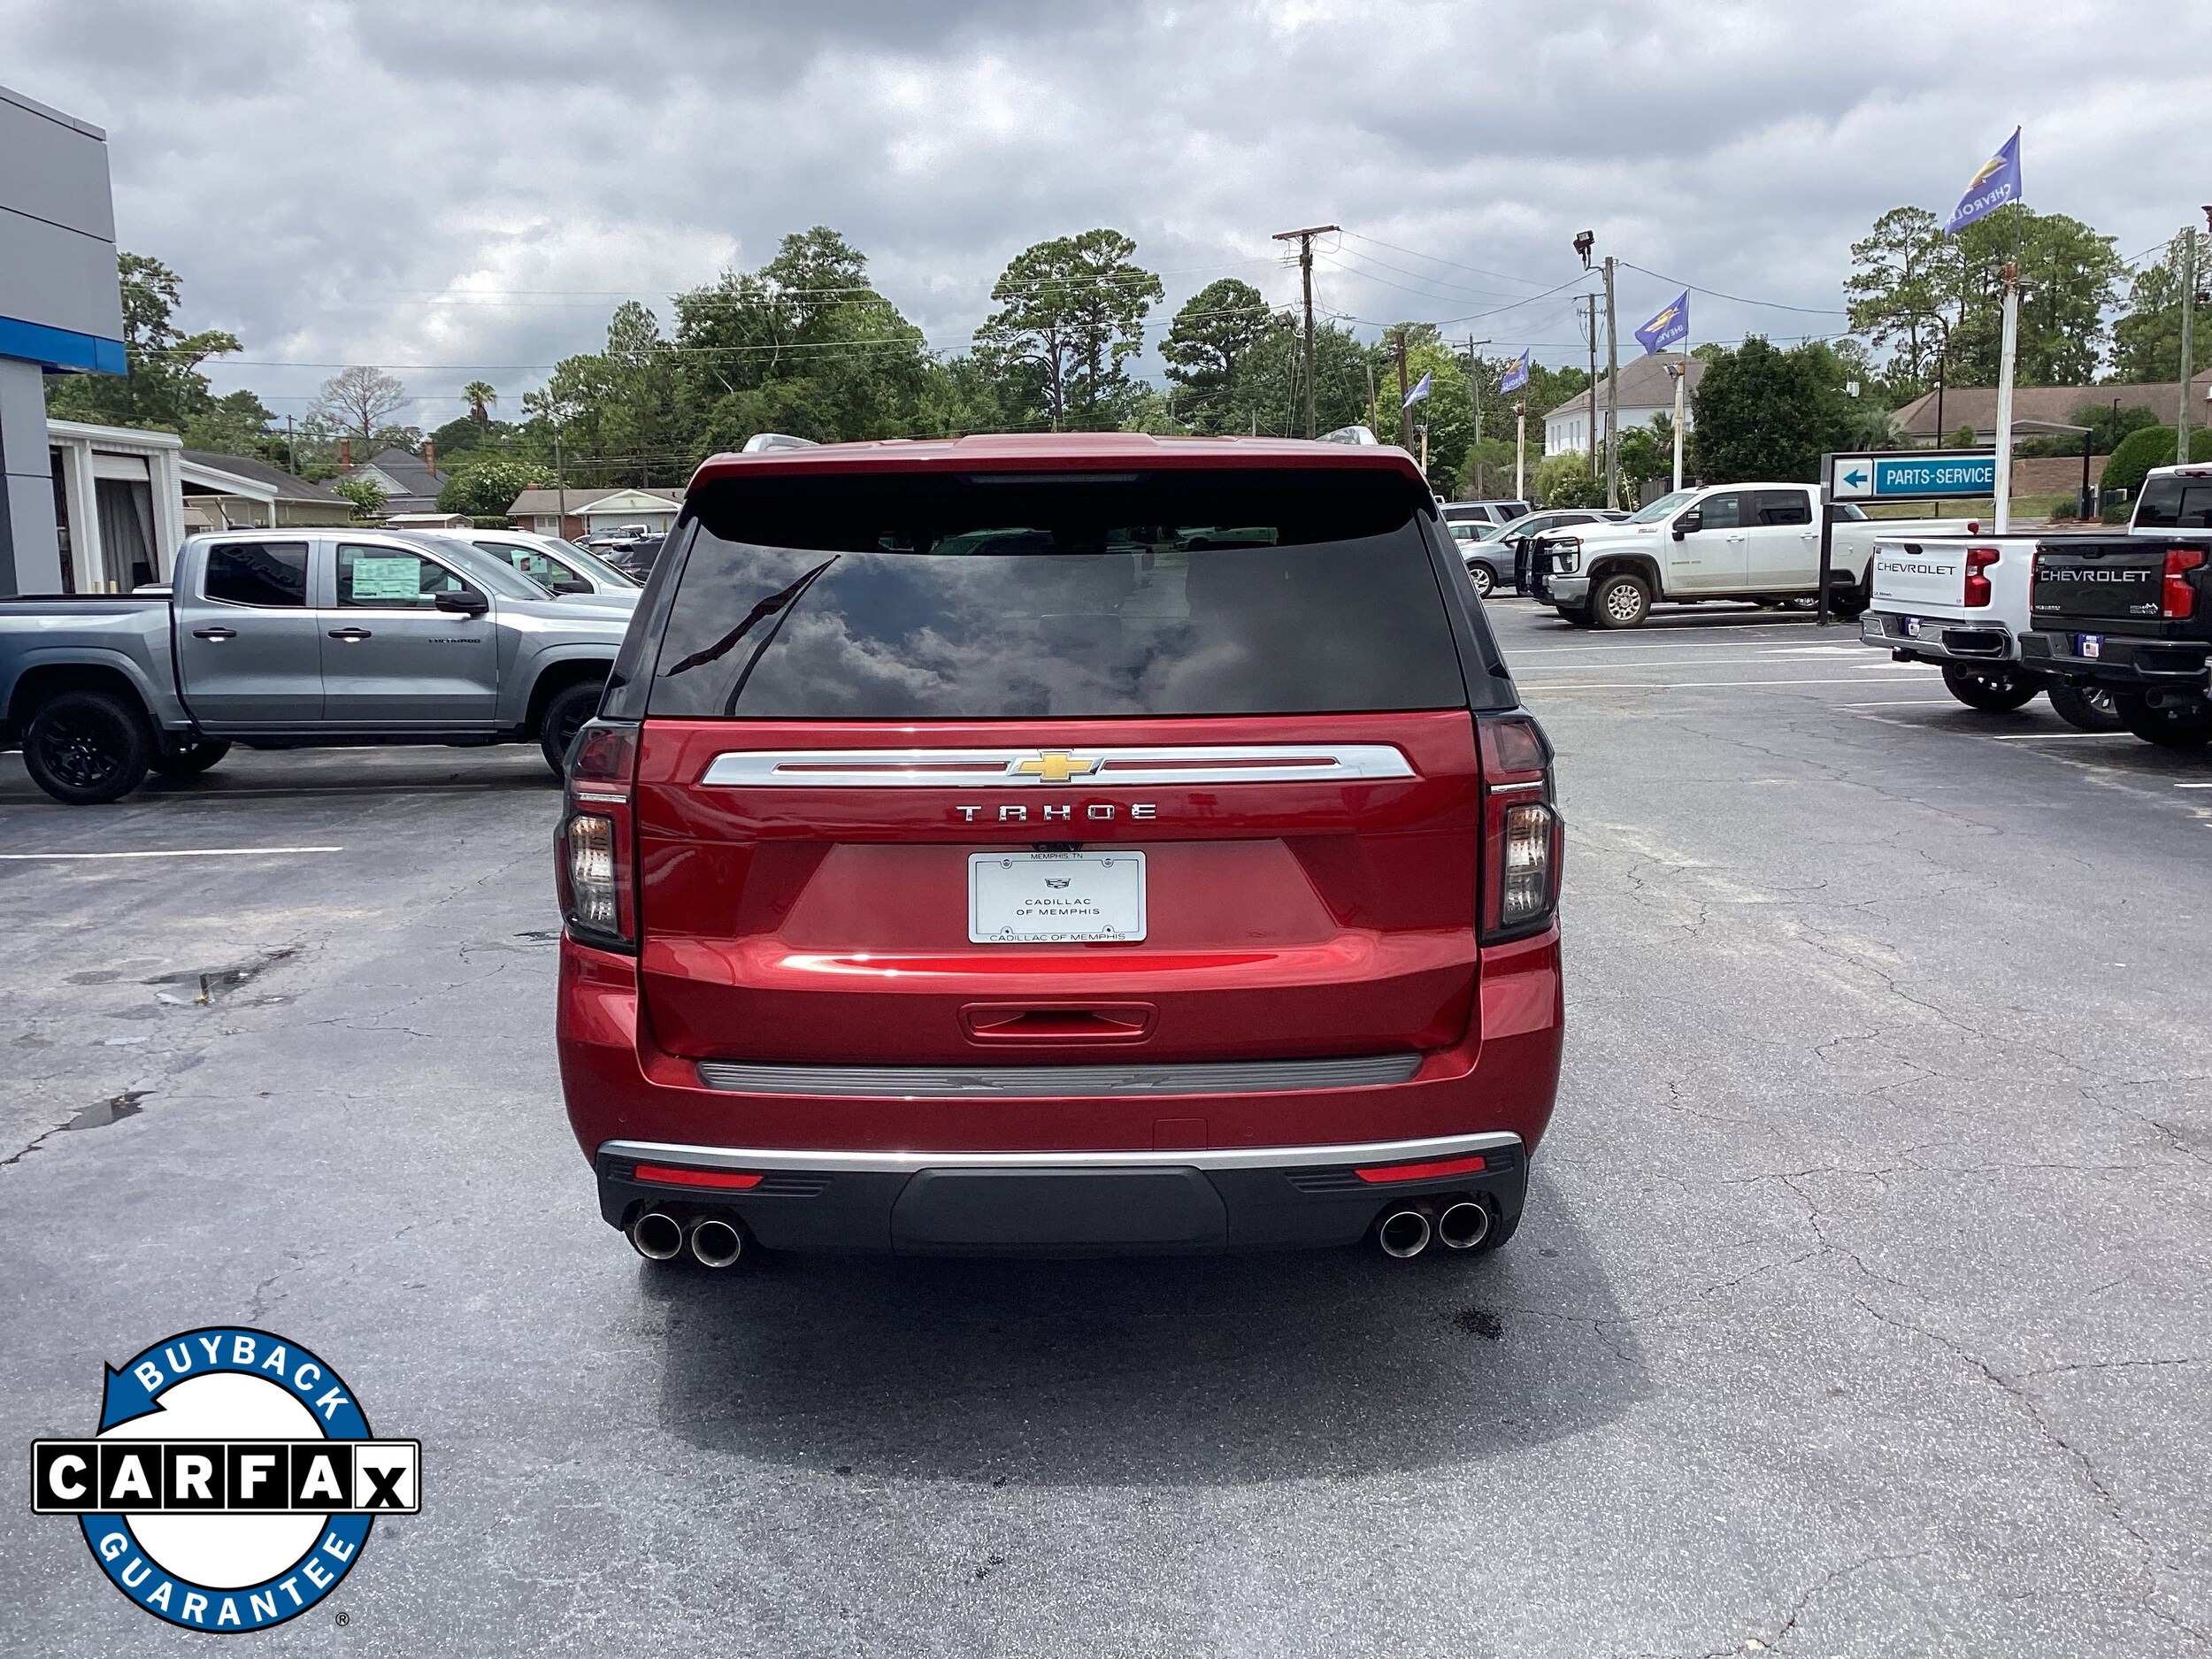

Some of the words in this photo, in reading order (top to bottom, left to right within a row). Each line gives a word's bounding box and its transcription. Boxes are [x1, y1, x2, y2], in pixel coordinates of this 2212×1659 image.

[1886, 467, 1993, 485] PARTS-SERVICE
[1878, 562, 1957, 576] CHEVROLET
[2040, 570, 2151, 582] CHEVROLET
[956, 803, 1156, 822] TAHOE
